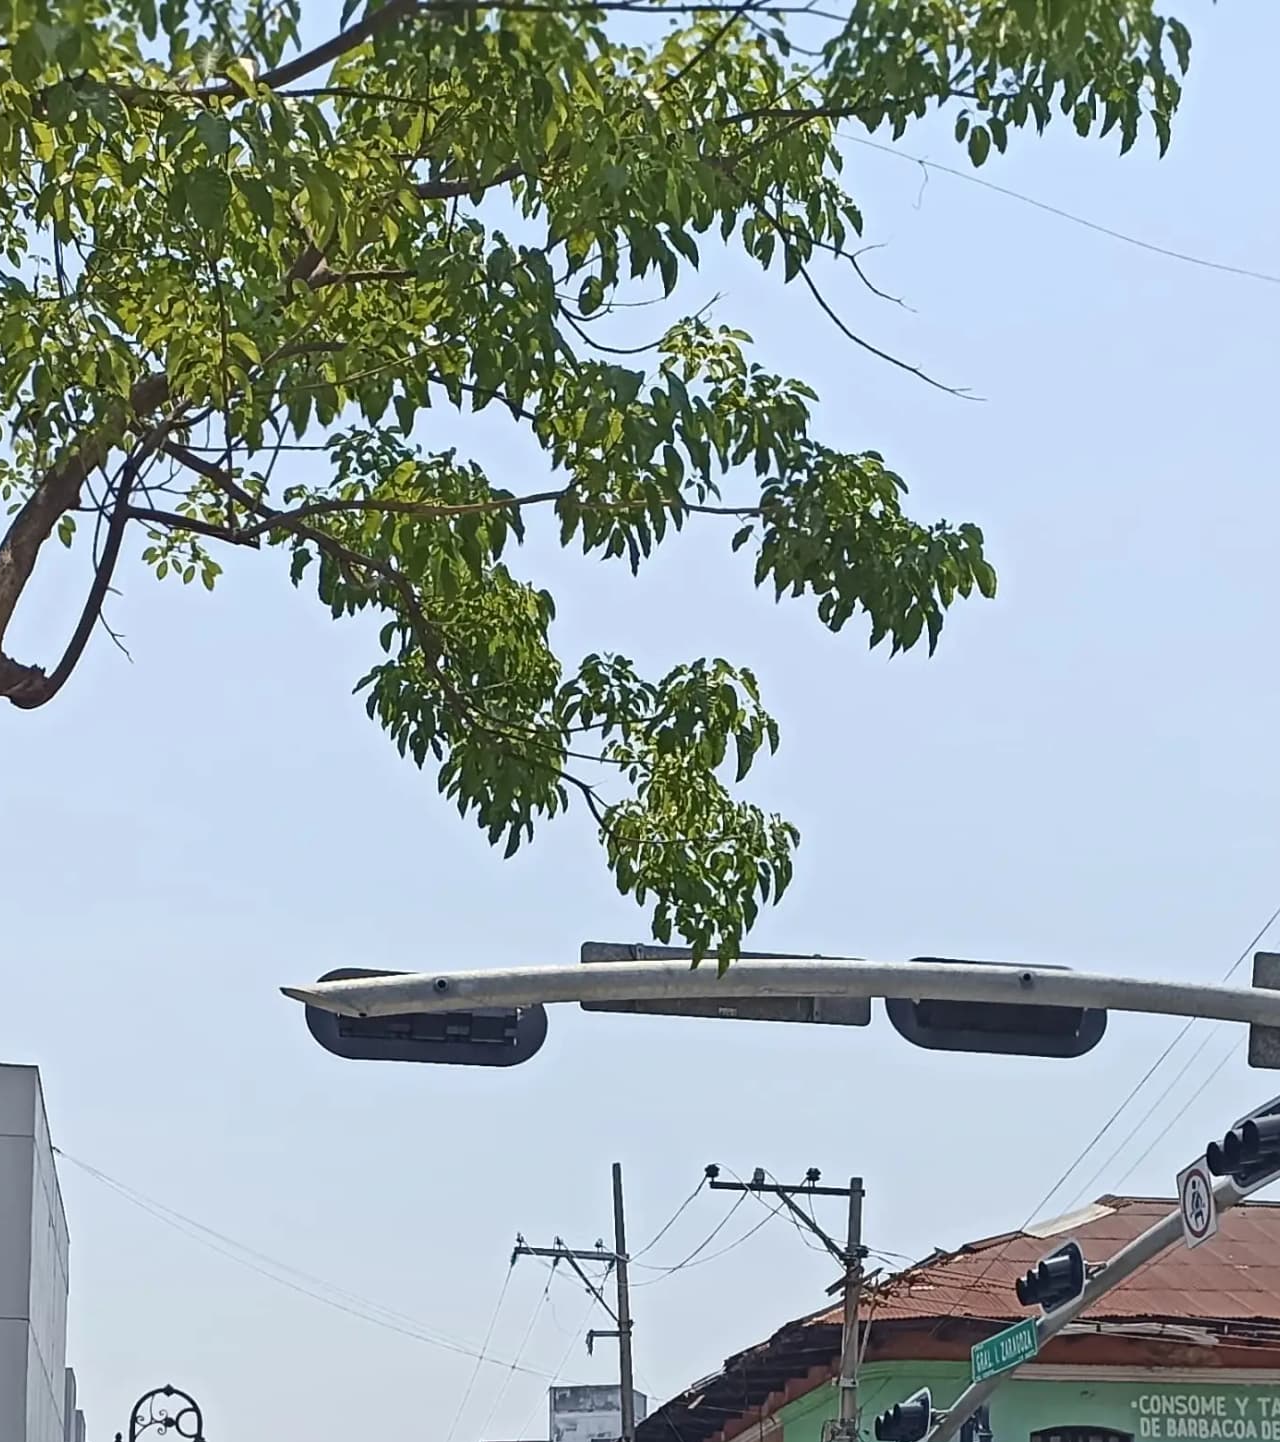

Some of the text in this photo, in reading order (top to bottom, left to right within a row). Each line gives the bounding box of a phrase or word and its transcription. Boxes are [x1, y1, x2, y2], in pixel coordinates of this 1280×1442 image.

[1236, 1397, 1250, 1416] Y
[1140, 1417, 1161, 1437] DE
[1167, 1418, 1258, 1438] BARBACOA
[1261, 1421, 1280, 1440] DE
